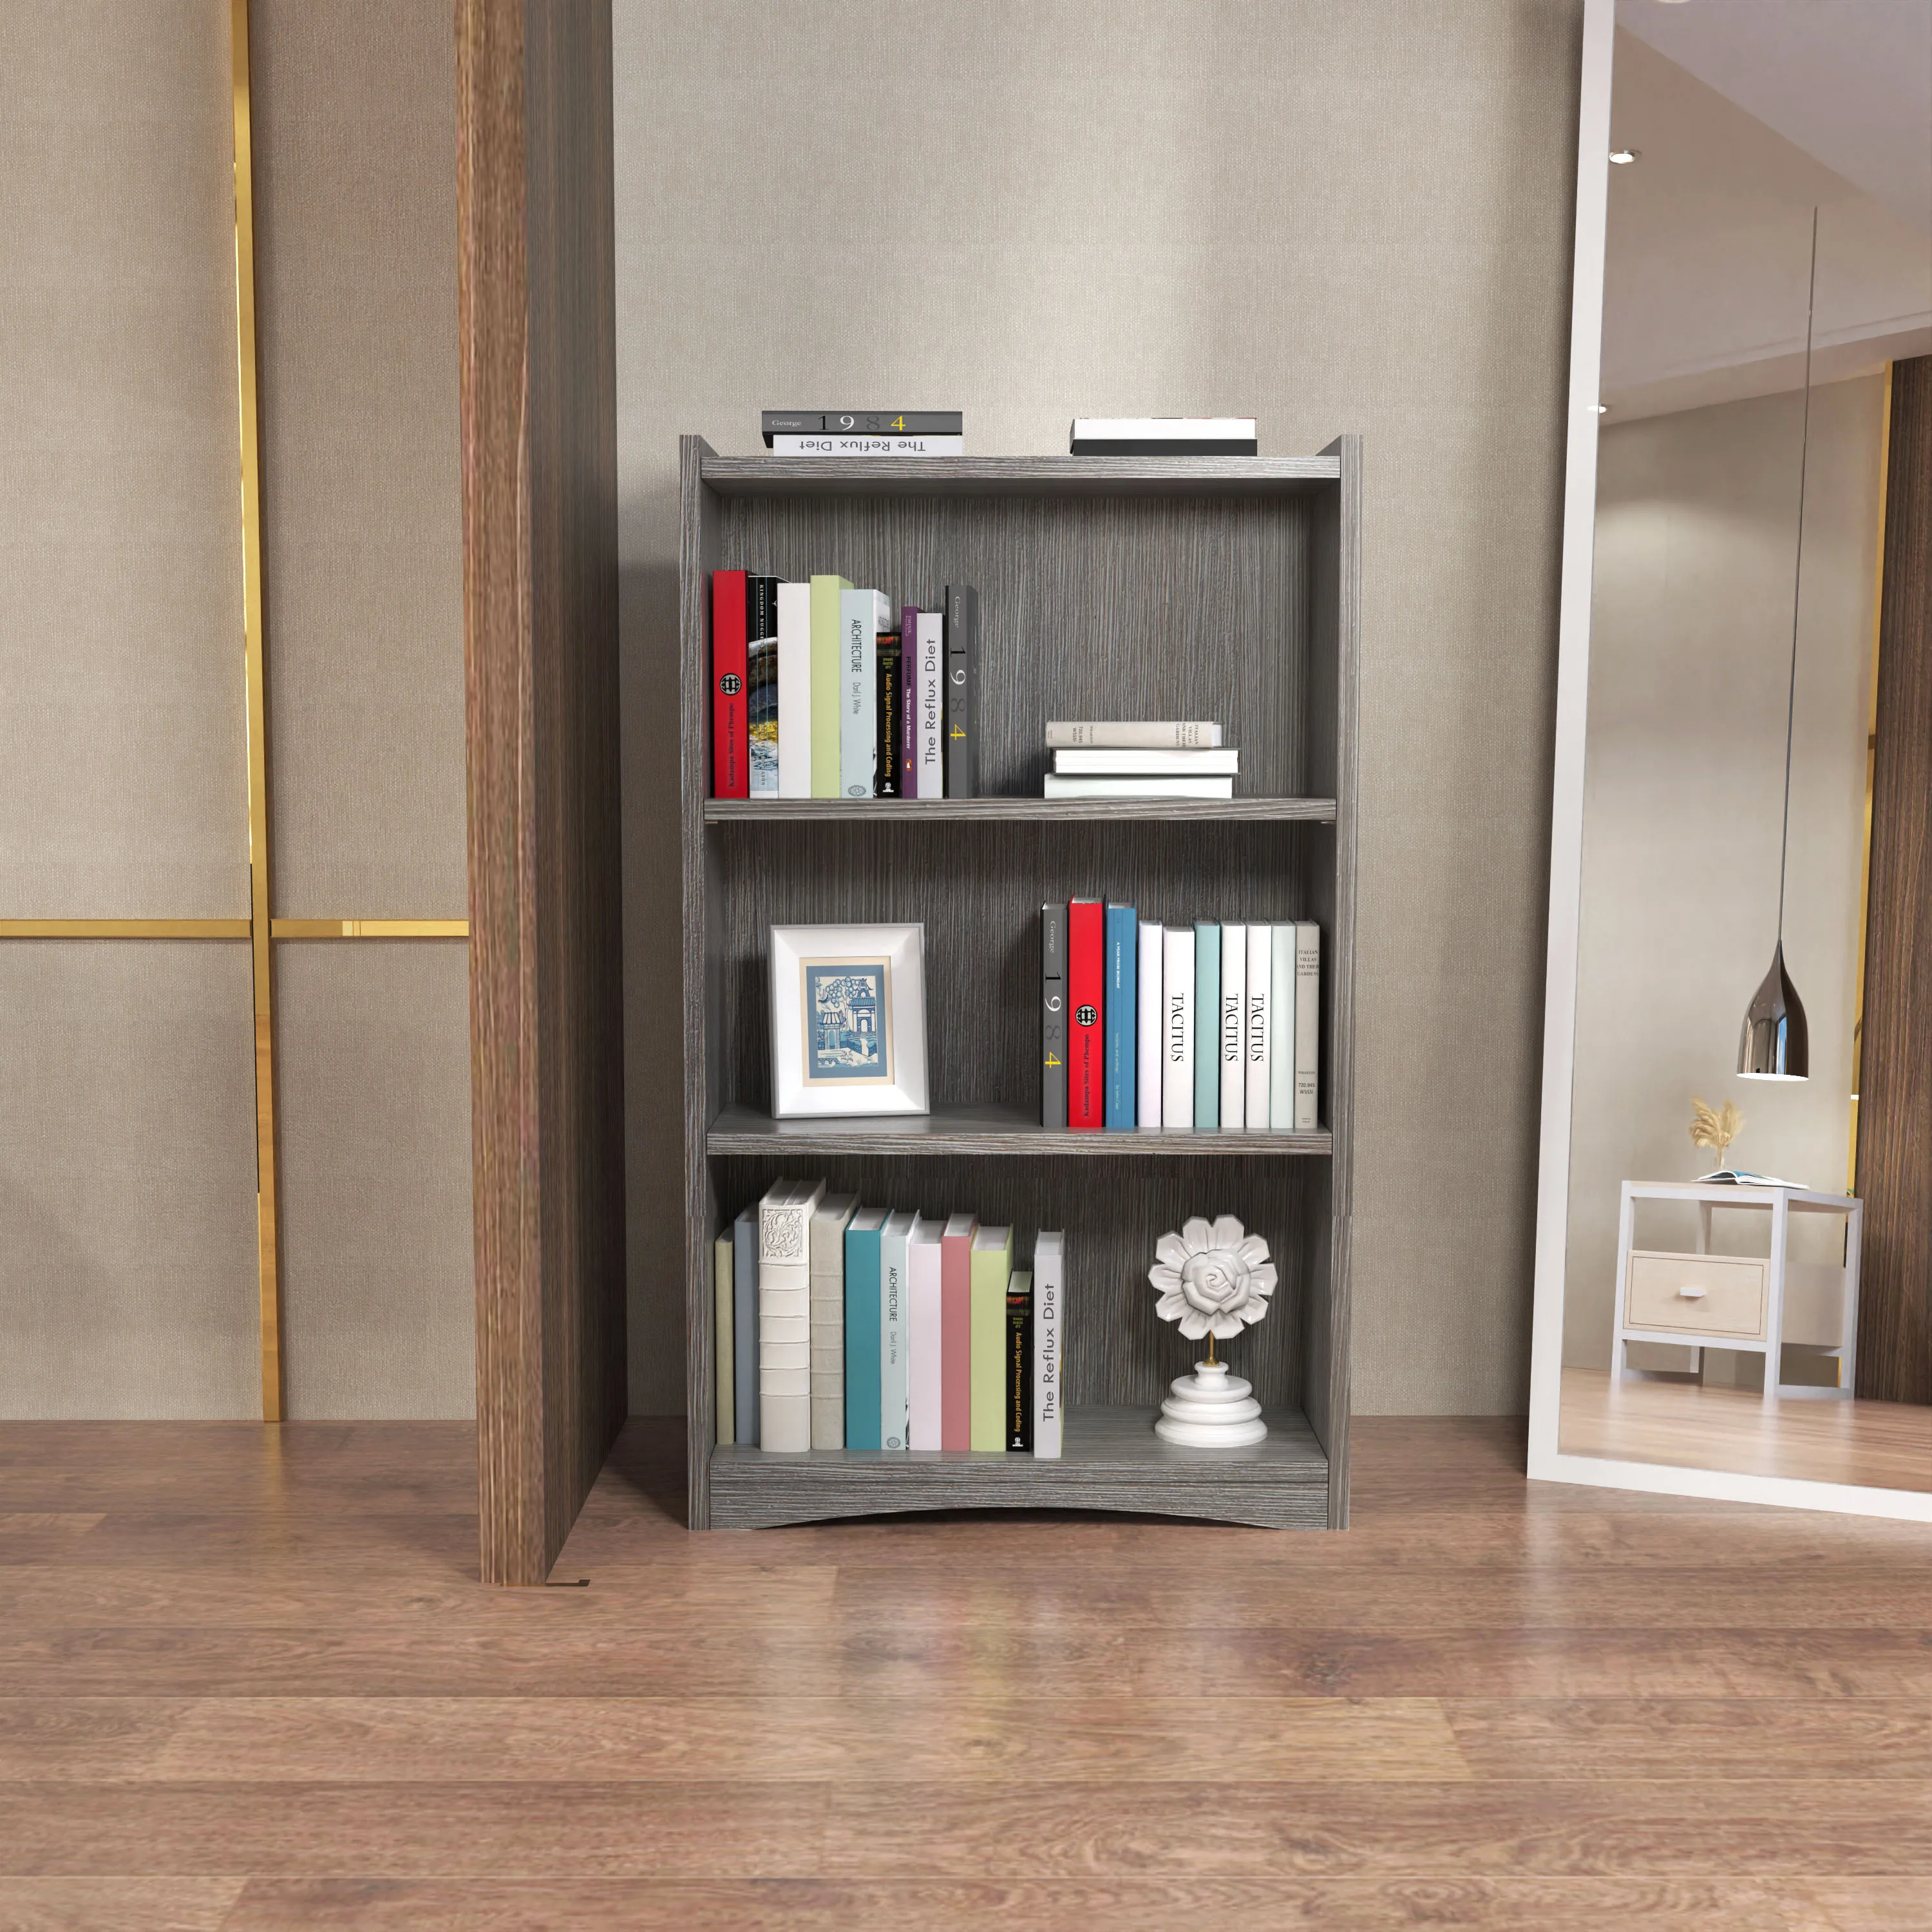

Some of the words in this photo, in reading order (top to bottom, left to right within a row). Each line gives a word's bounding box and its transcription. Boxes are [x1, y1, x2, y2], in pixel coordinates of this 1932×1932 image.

[799, 441, 832, 451] Diet
[839, 441, 890, 451] Reflux
[897, 441, 926, 451] The
[851, 619, 862, 673] ARCHITECTURE
[924, 639, 936, 672] Diet
[852, 699, 861, 715] White
[884, 692, 893, 710] Signal
[924, 679, 936, 730] Reflux
[884, 712, 893, 743] Processing
[924, 736, 936, 765] The
[884, 756, 893, 777] Coding
[1048, 920, 1056, 954] George
[1171, 993, 1184, 1062] TACITUS
[1225, 993, 1238, 1061] TACITUS
[1251, 993, 1264, 1061] TACITUS
[889, 1267, 898, 1322] ARCHITECTURE
[1043, 1283, 1054, 1320] Diet
[1014, 1332, 1023, 1349] Audio
[1043, 1327, 1054, 1383] Reflux
[1013, 1350, 1023, 1368] Signal
[1013, 1369, 1023, 1399] Processing
[1014, 1399, 1023, 1412] and
[1043, 1391, 1054, 1422] The
[1013, 1412, 1023, 1432] Coding
